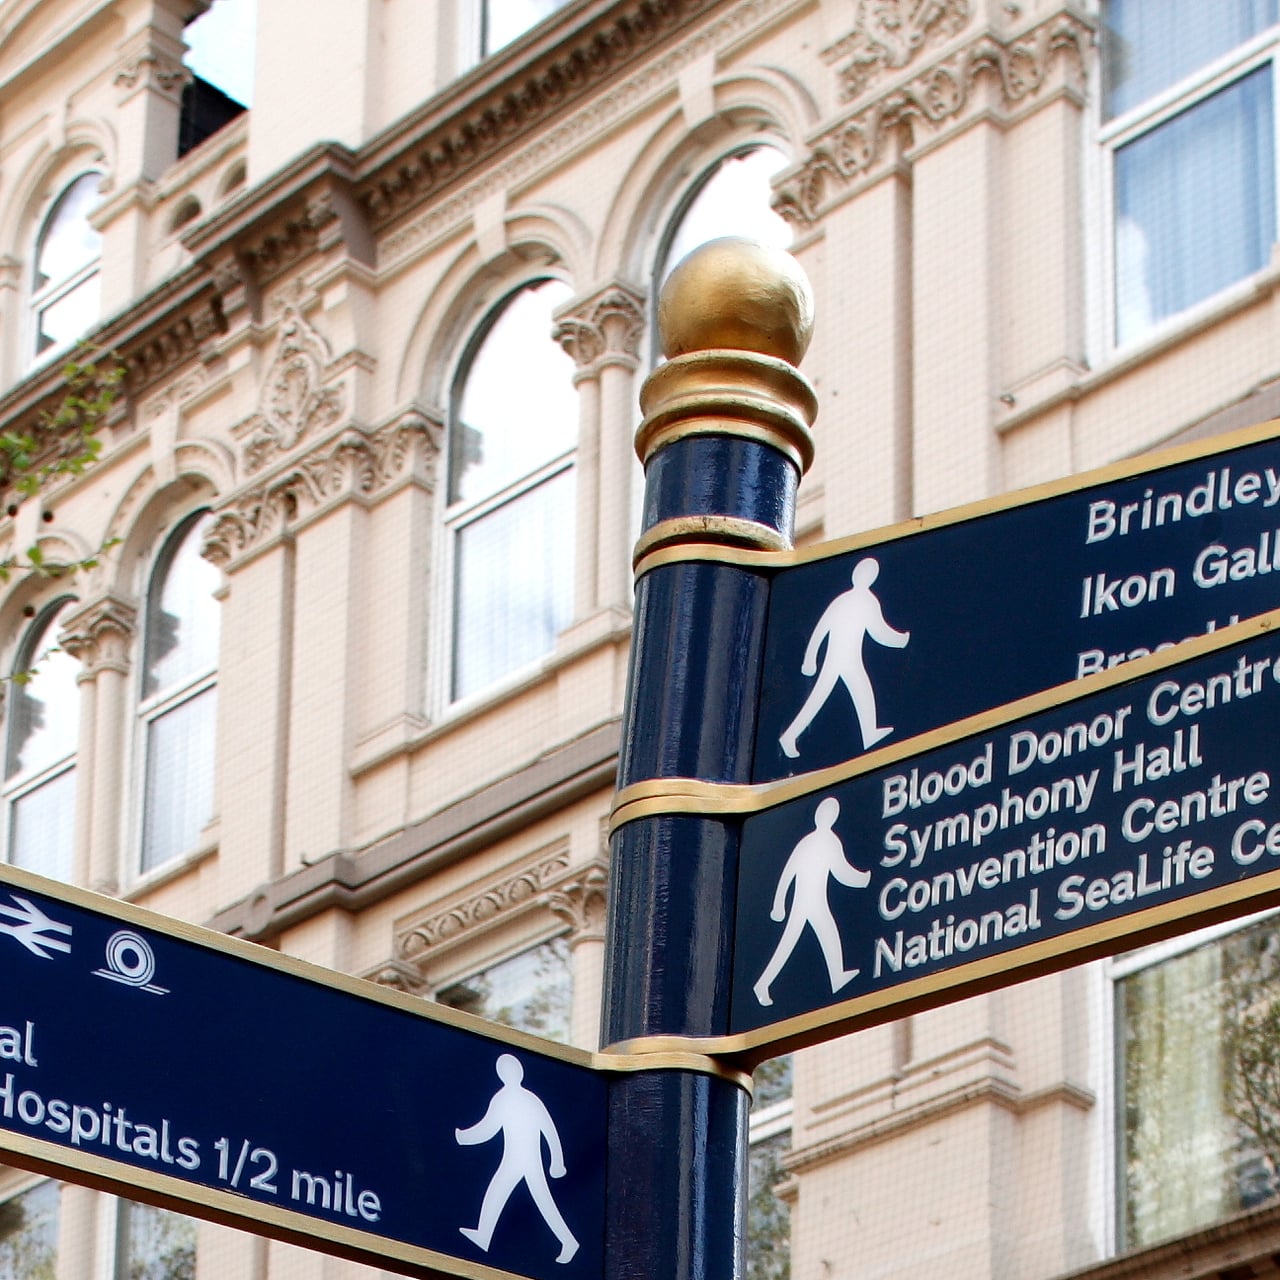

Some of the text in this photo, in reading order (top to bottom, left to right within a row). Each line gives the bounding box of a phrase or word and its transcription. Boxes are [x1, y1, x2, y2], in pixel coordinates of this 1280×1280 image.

[1080, 567, 1175, 618] Ikon
[879, 725, 1203, 868] Symphony Hall
[882, 743, 993, 818] Blood
[1008, 705, 1131, 775] Donor
[878, 771, 1270, 921] Convention Centre
[873, 888, 1041, 978] National
[1054, 840, 1214, 920] SeaLife
[214, 1137, 279, 1194] 1/2
[291, 1169, 381, 1223] mile
